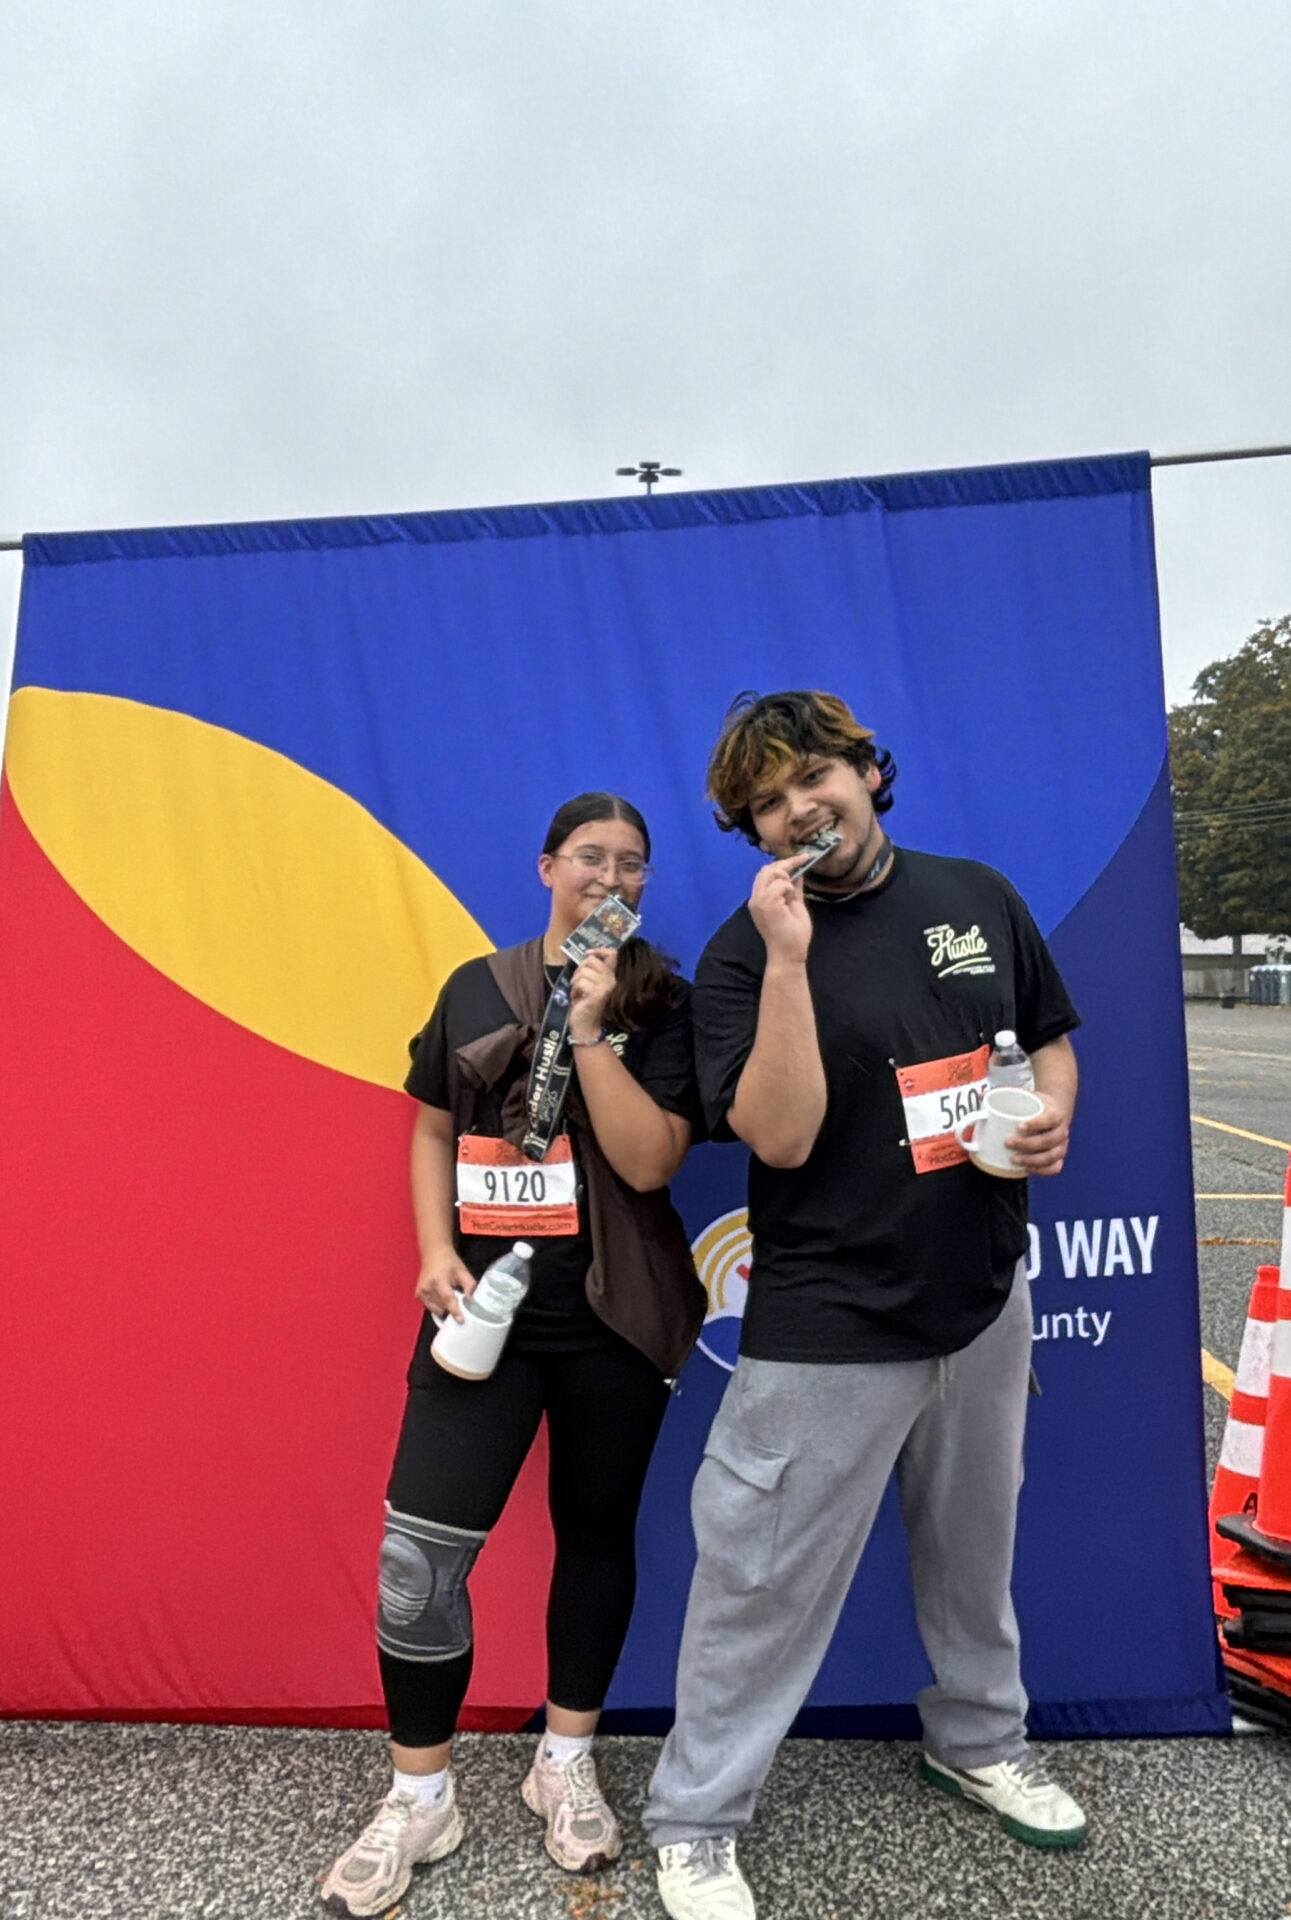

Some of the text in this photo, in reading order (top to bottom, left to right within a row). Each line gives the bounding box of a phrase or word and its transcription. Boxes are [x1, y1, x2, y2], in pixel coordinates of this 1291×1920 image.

[927, 924, 988, 966] Hustle
[535, 1030, 560, 1081] Hustle
[484, 1170, 546, 1202] 9120
[1055, 1215, 1159, 1279] WAY
[1031, 1306, 1112, 1347] unty
